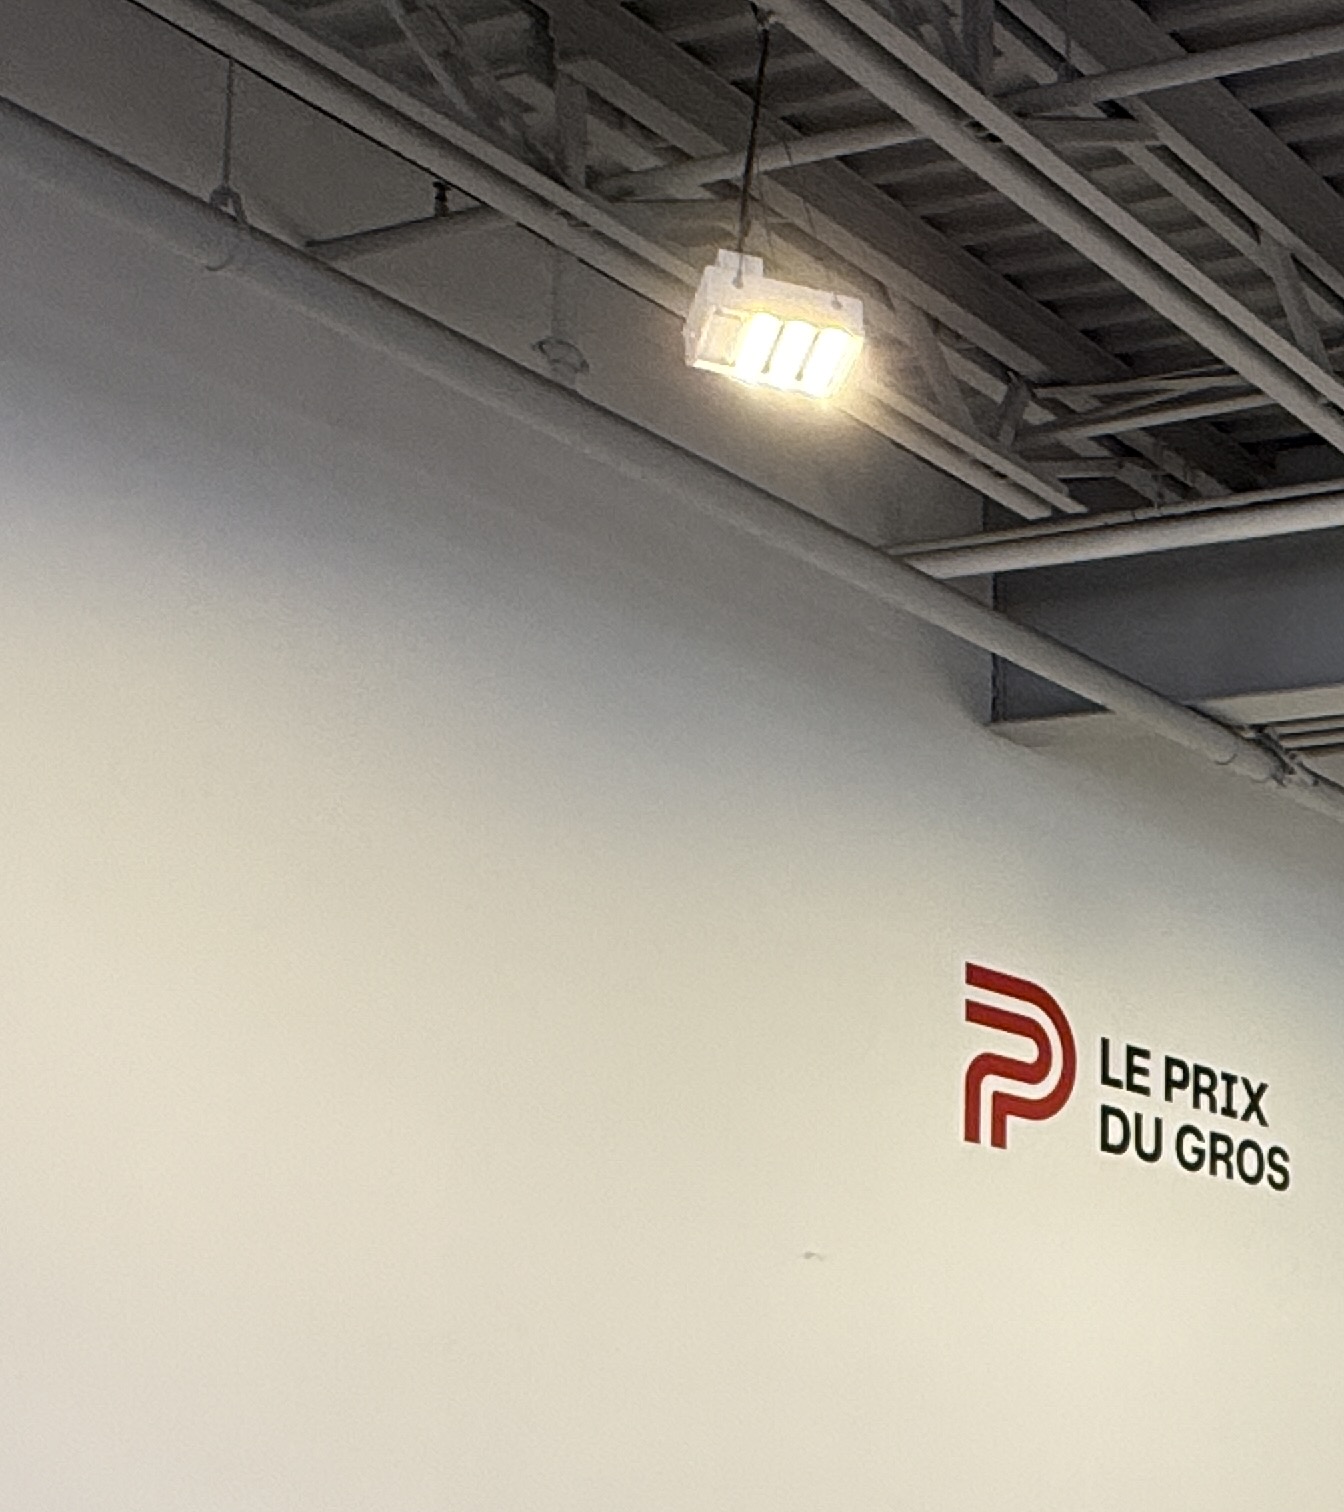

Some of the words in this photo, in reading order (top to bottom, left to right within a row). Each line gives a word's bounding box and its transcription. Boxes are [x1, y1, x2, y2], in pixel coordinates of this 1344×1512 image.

[1101, 1037, 1150, 1096] LE
[1164, 1055, 1269, 1127] PRIX
[1101, 1104, 1162, 1162] DU
[1175, 1125, 1290, 1191] GROS
